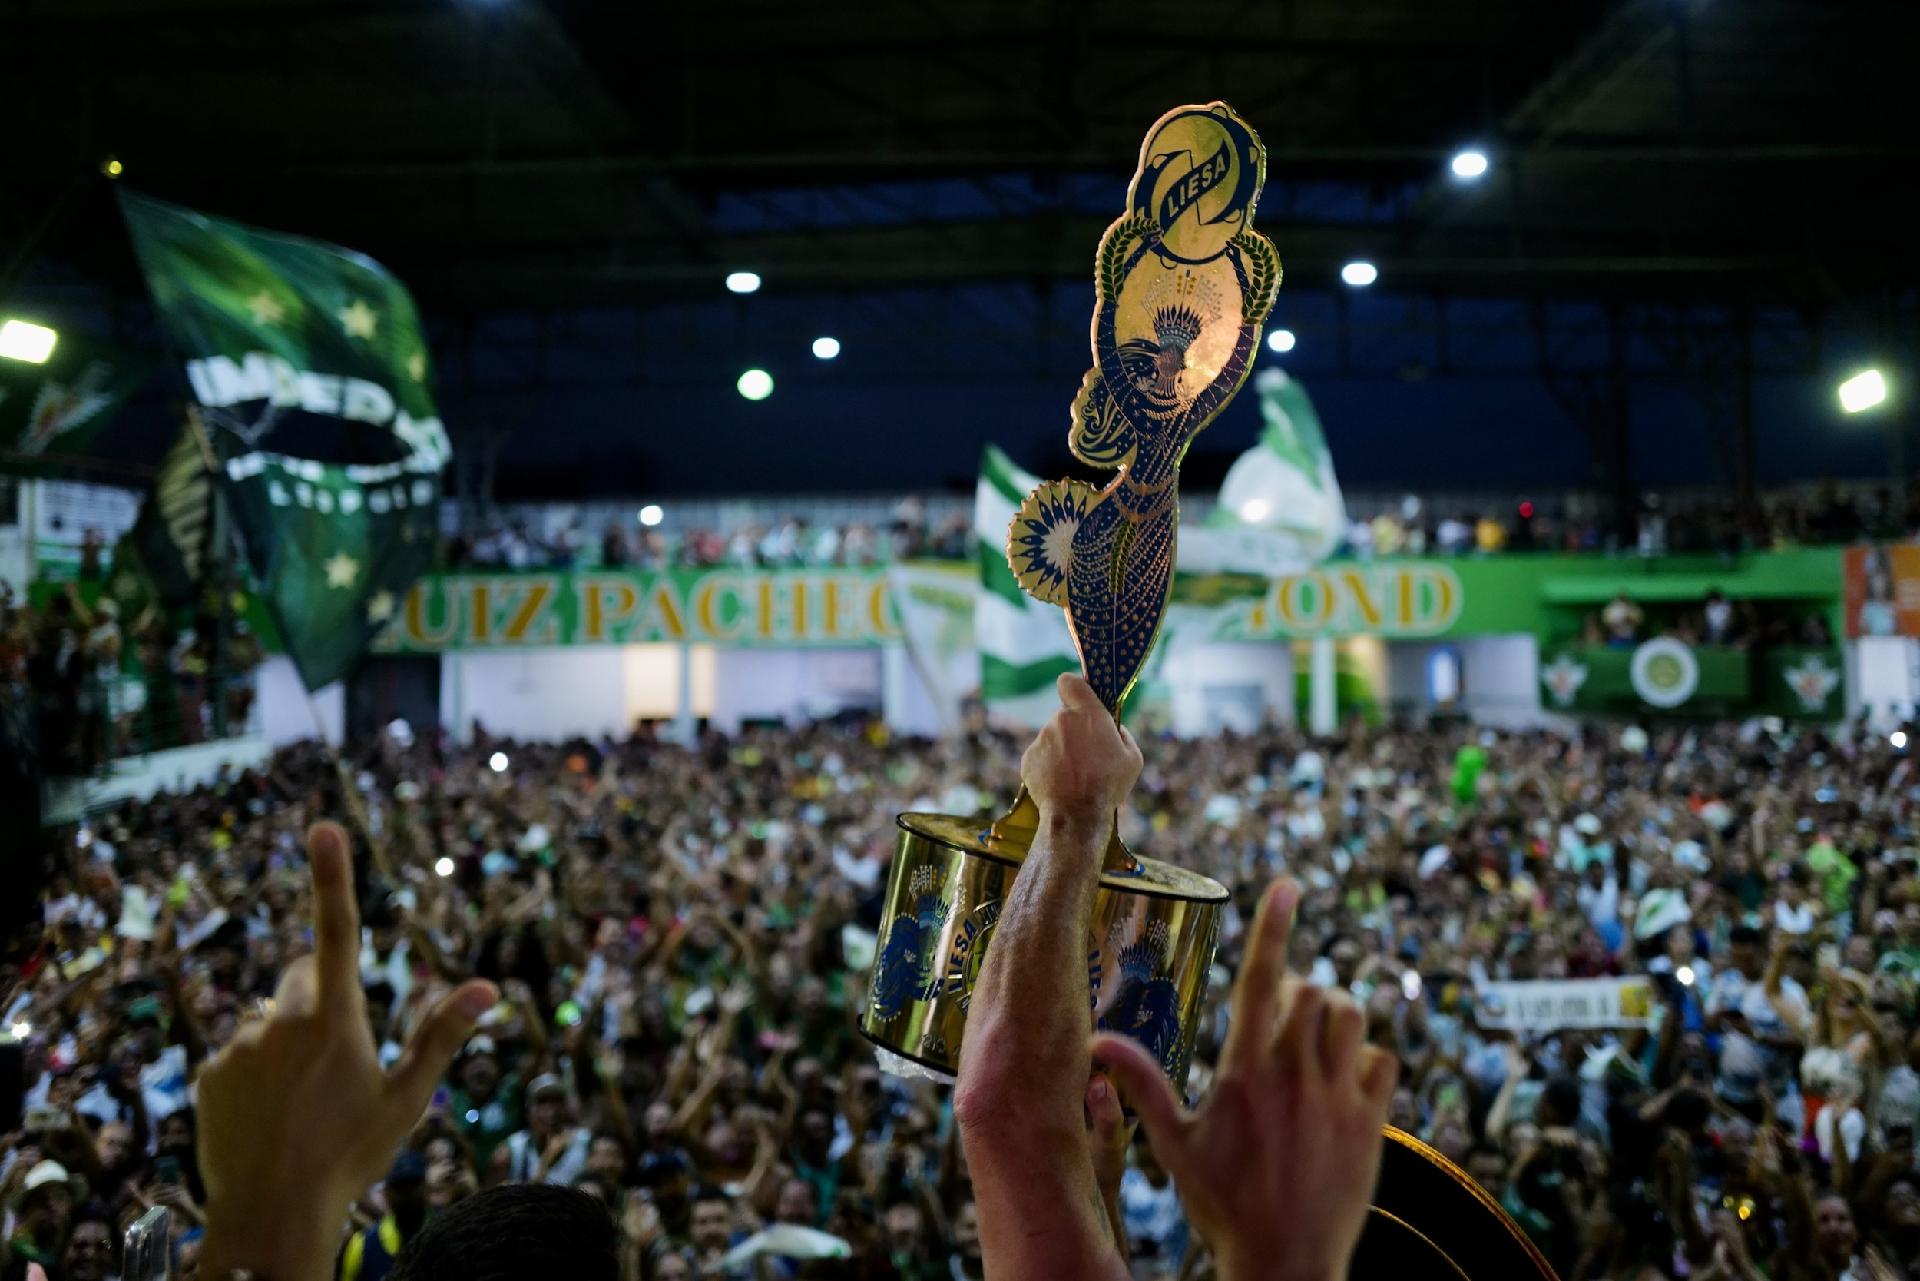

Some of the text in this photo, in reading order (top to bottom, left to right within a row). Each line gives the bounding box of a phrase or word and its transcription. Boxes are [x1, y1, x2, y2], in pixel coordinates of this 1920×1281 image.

[1167, 152, 1227, 218] LIESA
[576, 571, 902, 644] PACHEC
[1246, 563, 1461, 637] OND
[948, 918, 977, 994] LIESA
